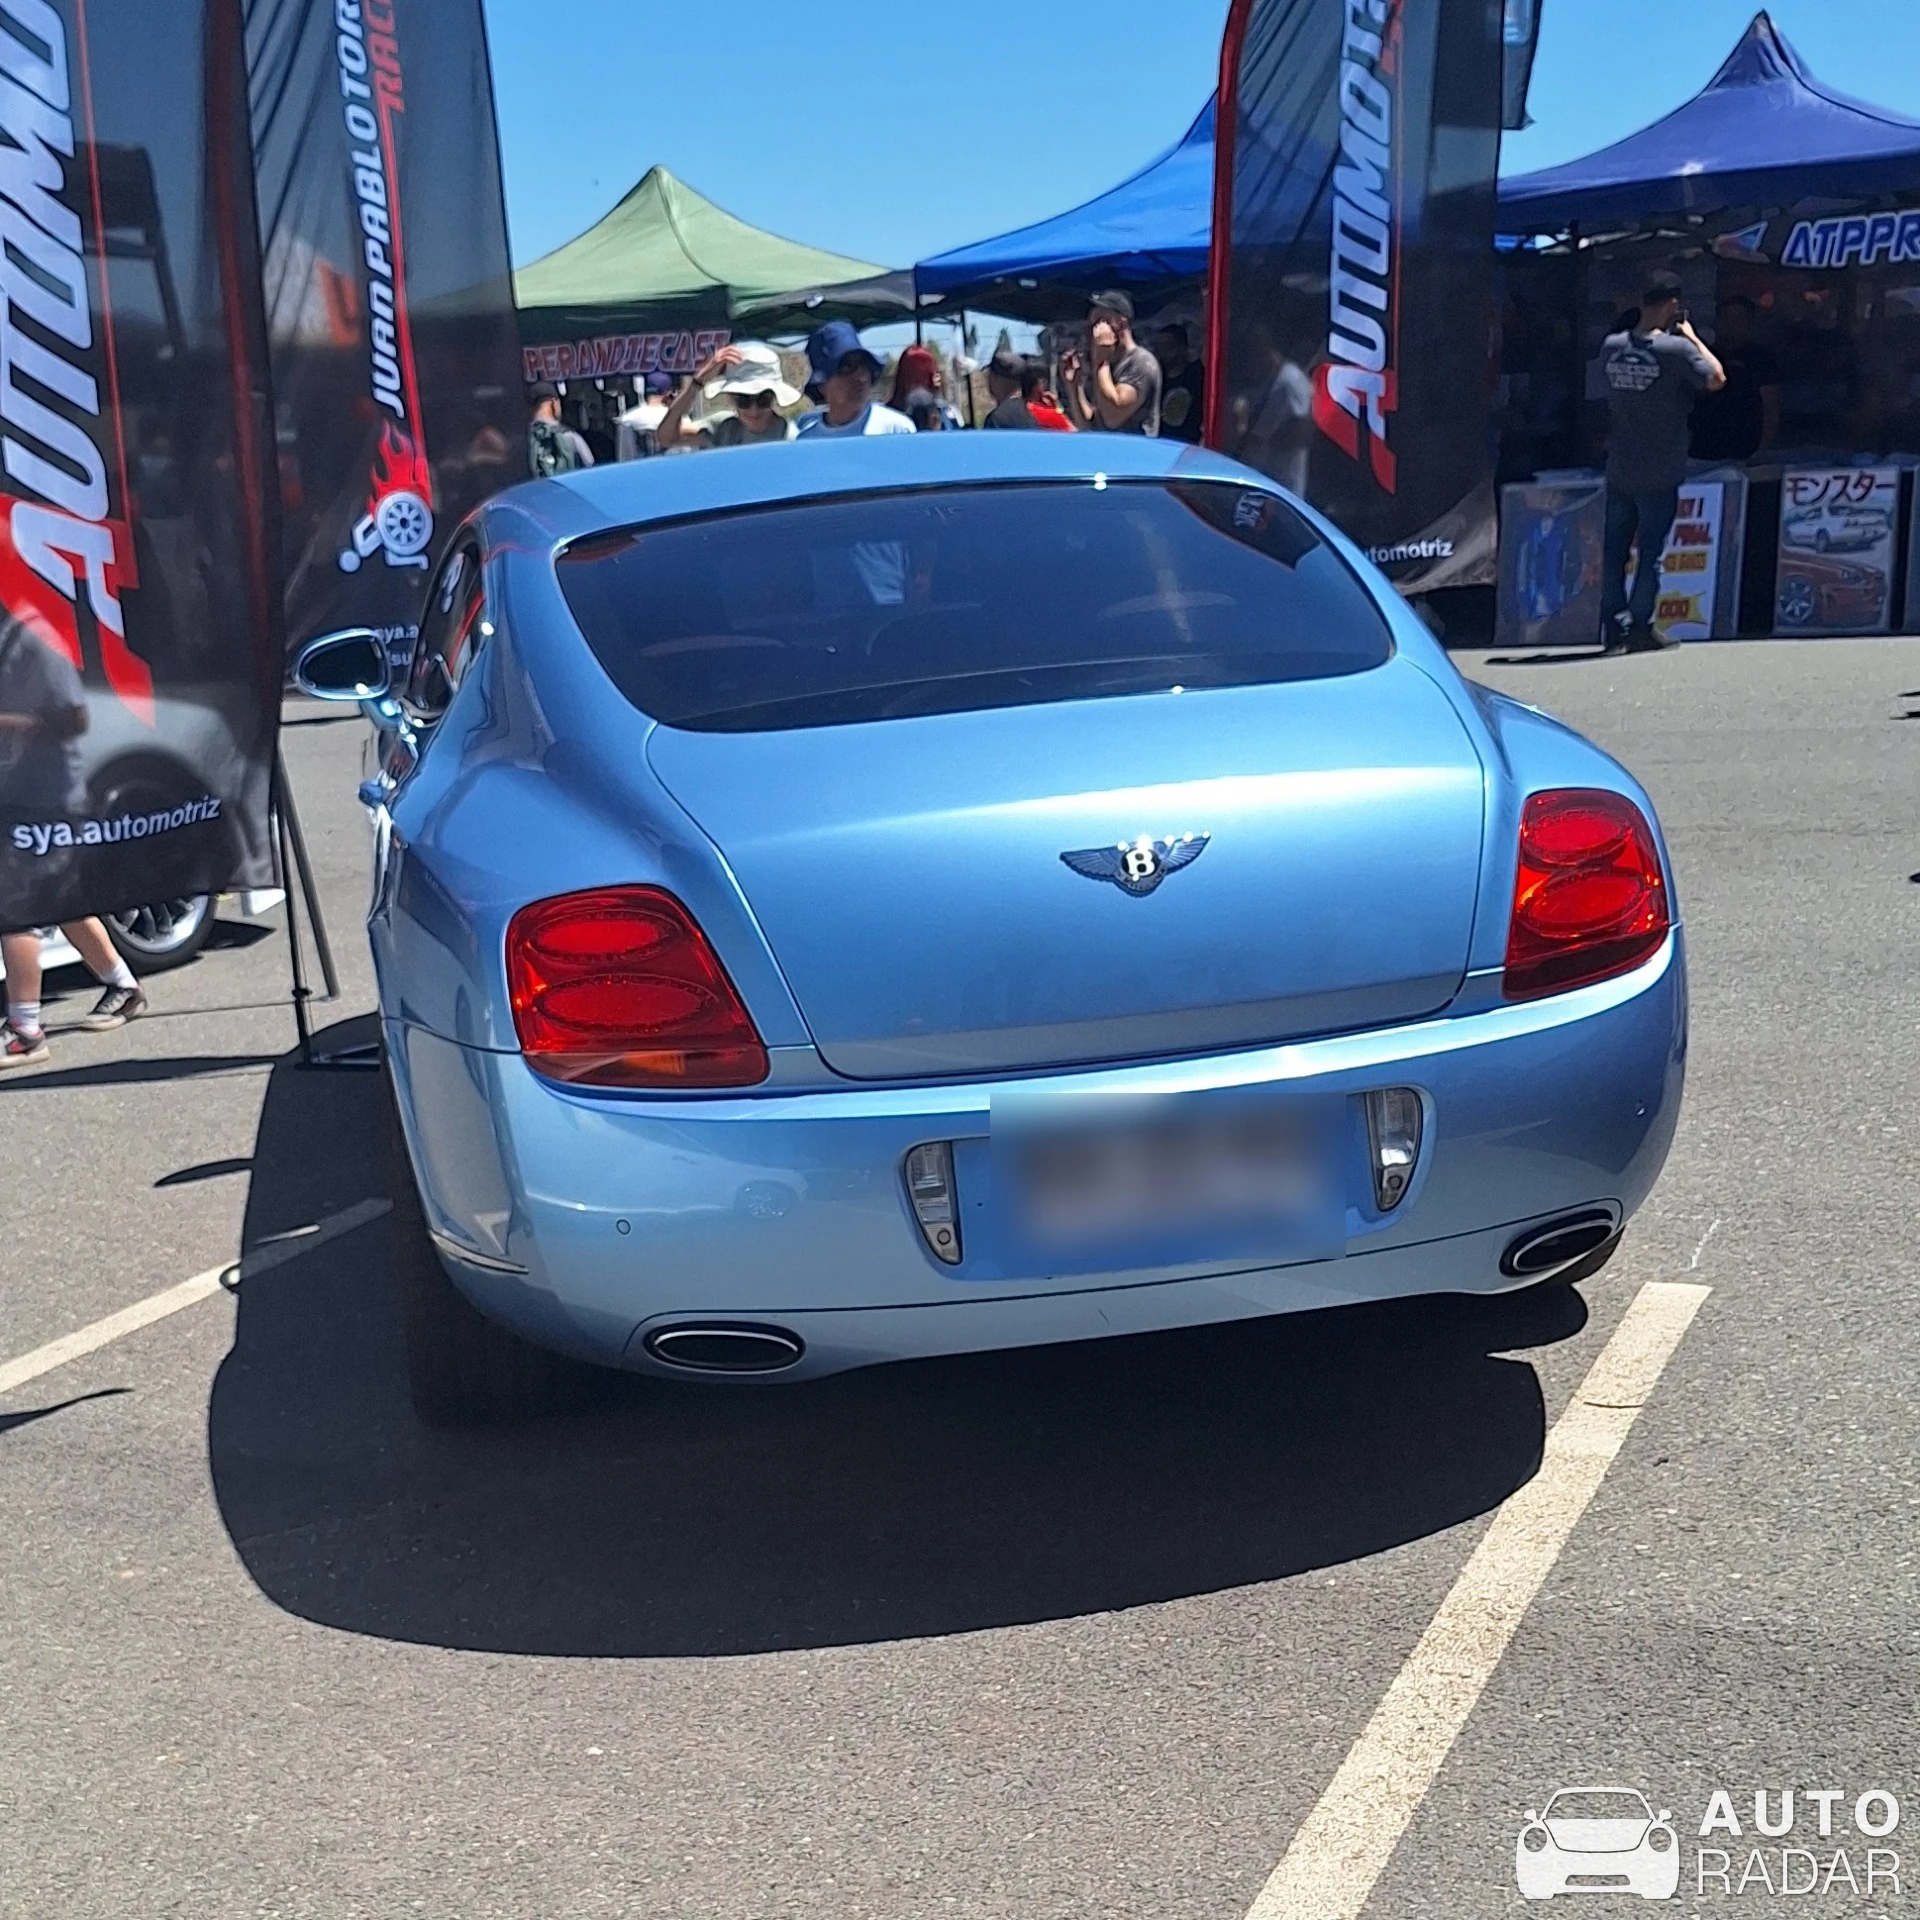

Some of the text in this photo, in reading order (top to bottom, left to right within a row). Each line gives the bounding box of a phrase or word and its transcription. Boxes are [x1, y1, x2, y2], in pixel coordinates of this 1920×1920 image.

[362, 0, 404, 113] RAC
[344, 103, 393, 279] PABLO
[1327, 0, 1392, 441] AUTOMOT
[369, 280, 405, 419] JUAN
[1786, 469, 1896, 506] モンスター
[1365, 537, 1454, 563] tomotriz
[12, 795, 222, 856] sya.automotriz
